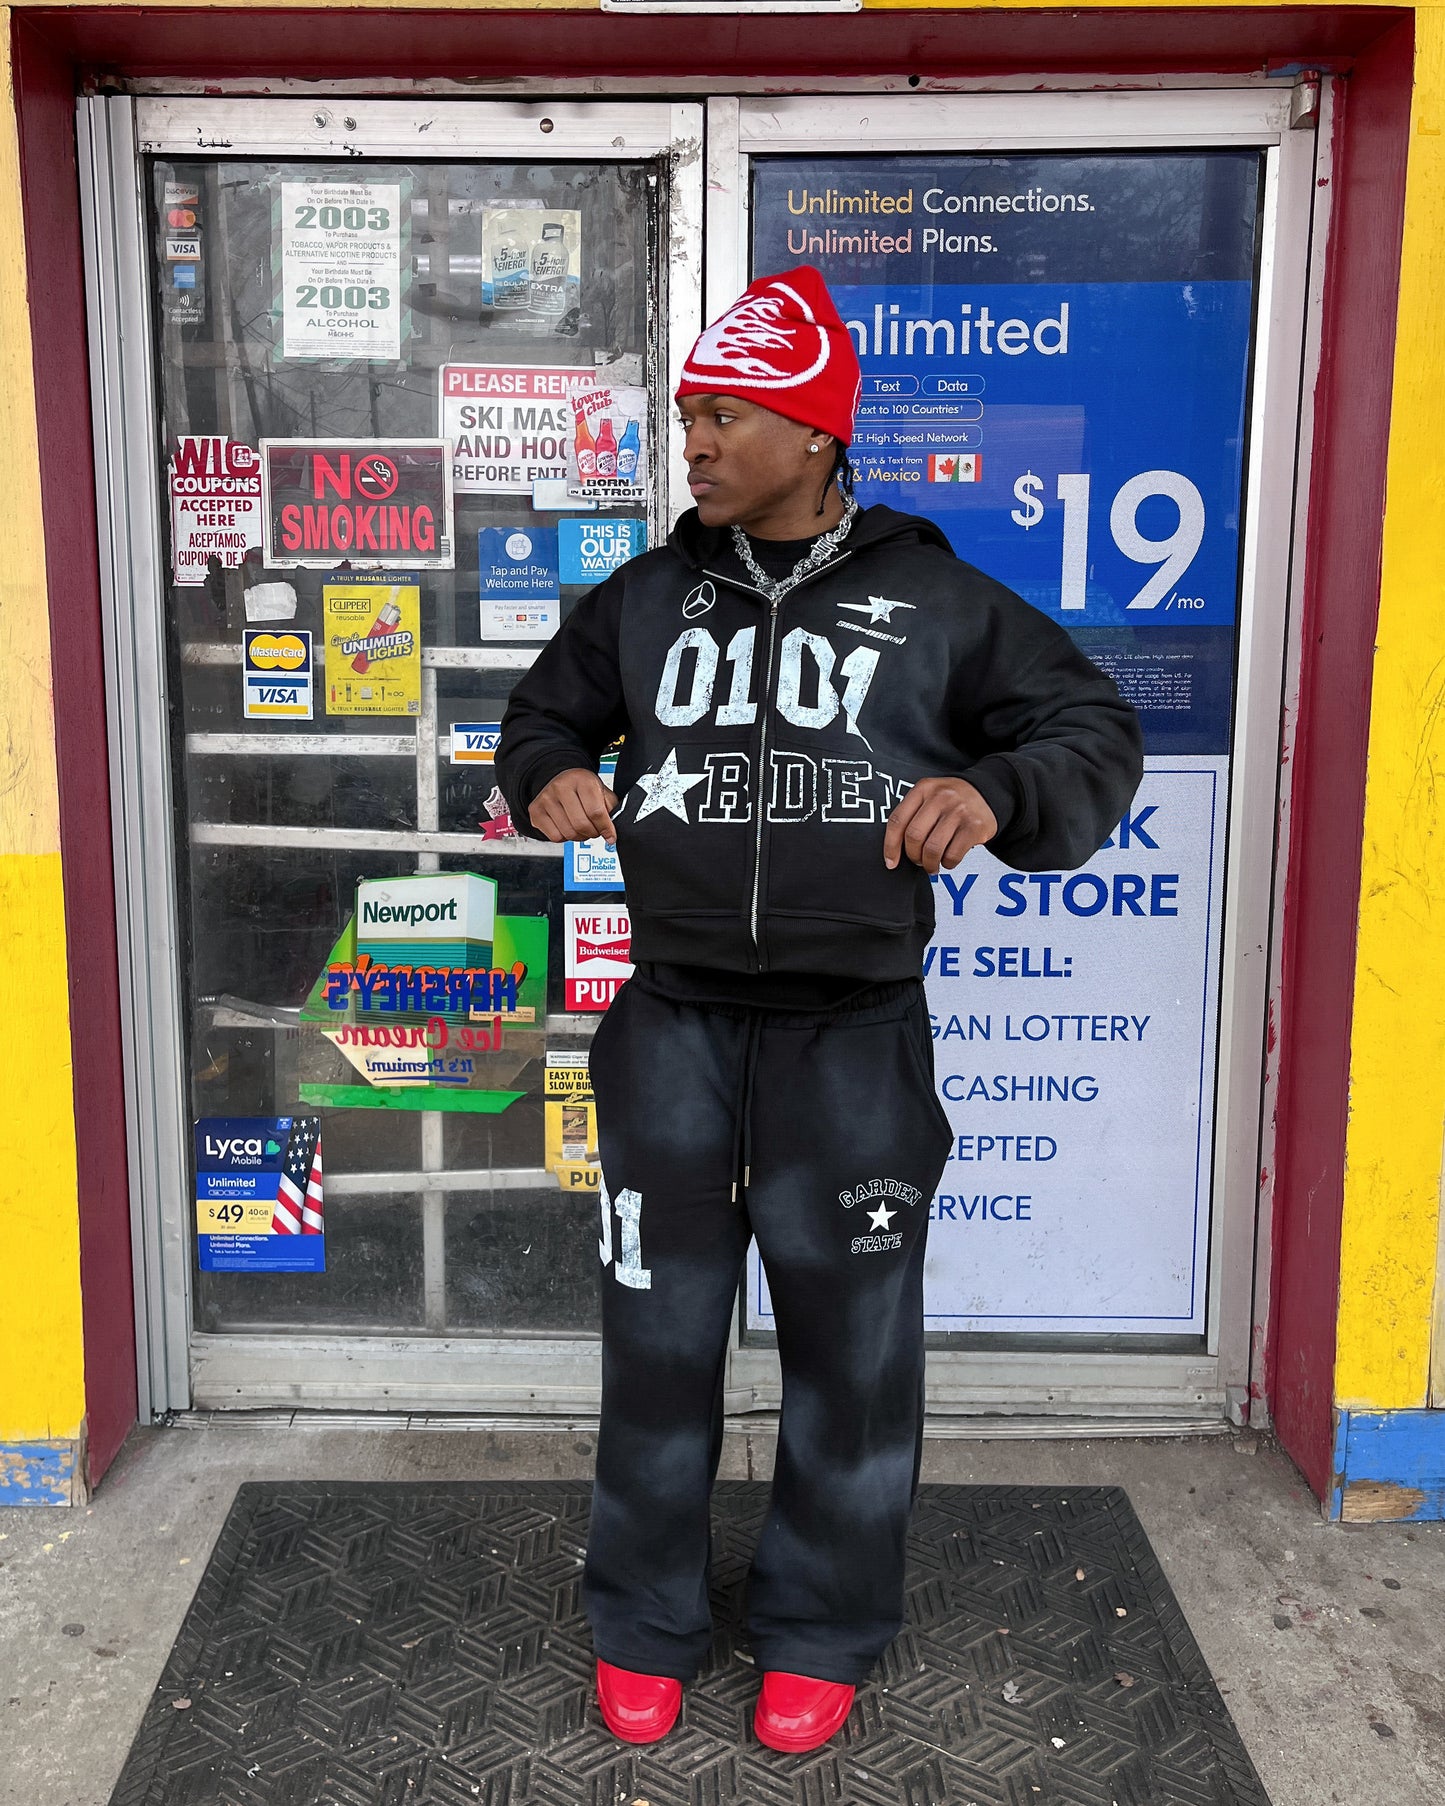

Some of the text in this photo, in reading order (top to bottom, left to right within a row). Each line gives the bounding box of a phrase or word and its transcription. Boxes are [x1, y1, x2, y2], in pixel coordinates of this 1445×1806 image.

[787, 187, 1095, 215] Unlimited Connections.
[294, 205, 390, 231] 2003
[291, 241, 325, 249] TOBACCO,
[326, 241, 348, 249] VAPOR
[349, 242, 385, 250] PRODUCTS
[787, 228, 998, 254] Unlimited Plans.
[172, 244, 196, 254] VISA
[285, 250, 397, 259] ALTERNATIVE NICOTINE PRODUCTS
[498, 259, 527, 272] ENERGY
[536, 266, 566, 275] ENERGY
[531, 283, 564, 293] EXTRA
[296, 285, 390, 310] 2003
[171, 316, 198, 324] Accepted
[306, 318, 379, 328] ALCOHOL
[448, 373, 596, 394] PLEASE REMO
[874, 380, 901, 392] Text
[938, 380, 968, 392] Data
[571, 389, 611, 412] towne
[586, 397, 613, 416] club
[857, 404, 876, 415] Text
[878, 405, 890, 415] to
[892, 404, 909, 414] 100
[460, 406, 503, 430] SKI
[866, 432, 891, 446] High
[892, 432, 924, 445] Speed
[926, 432, 969, 442] Network
[454, 435, 511, 459] AND
[174, 438, 260, 475] WIC
[862, 456, 878, 464] Talk
[879, 456, 886, 464] &
[887, 456, 904, 464] Text
[906, 456, 923, 464] from
[453, 465, 521, 482] BEFORE
[852, 467, 921, 482] & Mexico
[172, 477, 260, 494] COUPONS
[586, 479, 630, 487] BORN
[582, 488, 645, 496] DETROIT
[180, 499, 253, 512] ACCEPTED
[196, 514, 236, 526] HERE
[280, 504, 436, 552] SMOKING
[580, 524, 631, 538] THIS IS
[188, 532, 246, 548] ACEPTAMOS
[580, 538, 631, 557] OUR
[226, 552, 238, 566] DE
[490, 565, 548, 578] Tap and Pay
[485, 578, 554, 588] Welcome Here
[333, 601, 368, 610] CLIPPER
[343, 632, 412, 654] UNLIMITED
[250, 646, 305, 660] MasterCard
[367, 642, 412, 661] LIGHTS
[258, 688, 299, 704] VISA
[1099, 806, 1161, 849] K
[592, 856, 616, 865] Lyca
[930, 873, 1179, 917] Y STORE
[363, 898, 457, 926] Newport
[575, 917, 602, 935] WE
[579, 946, 630, 956] Budweiser
[972, 946, 1073, 978] SELL:
[1005, 1014, 1151, 1042] LOTTERY
[549, 1072, 570, 1080] EASY
[572, 1072, 584, 1080] TO
[549, 1082, 574, 1090] SLOW
[942, 1074, 1099, 1102] CASHING
[205, 1135, 262, 1160] Lyca
[947, 1135, 1057, 1162] EPTED
[231, 1156, 262, 1165] Mobile
[207, 1177, 256, 1187] Unlimited
[570, 1171, 598, 1187] PU
[838, 1178, 922, 1209] GARDEN
[850, 1232, 903, 1254] STATE
